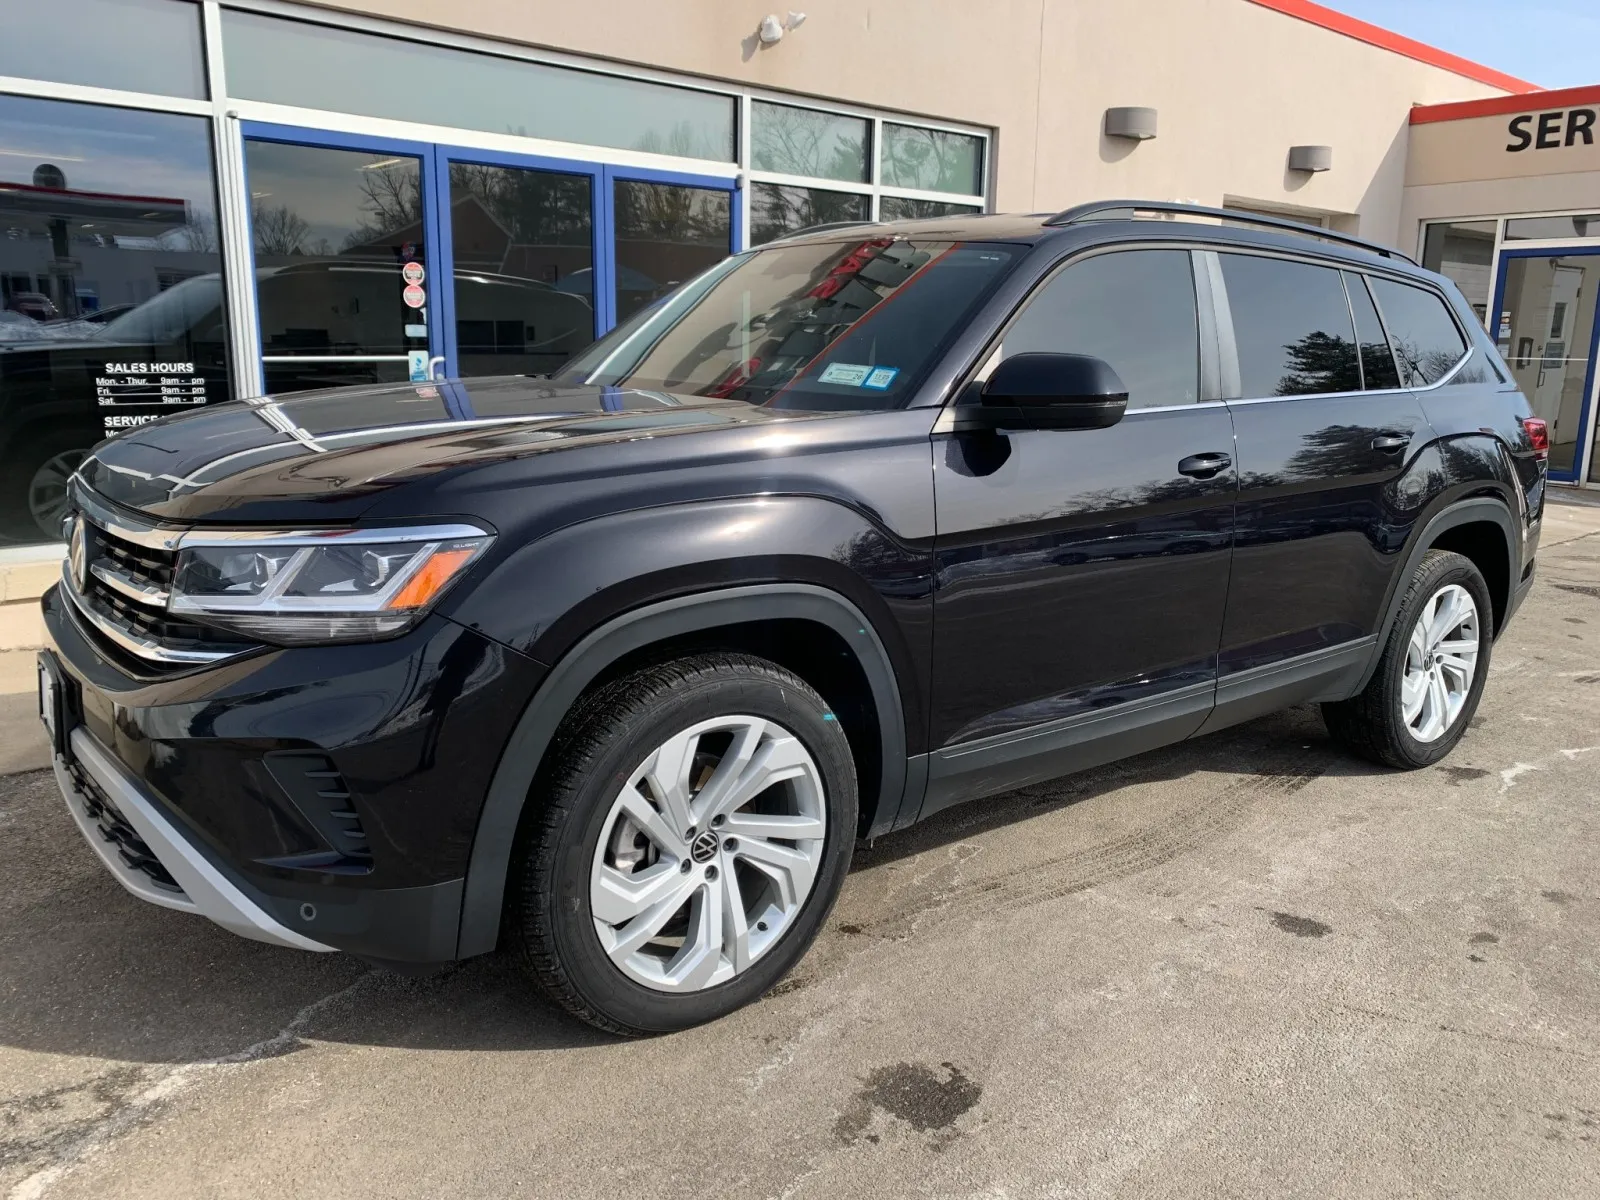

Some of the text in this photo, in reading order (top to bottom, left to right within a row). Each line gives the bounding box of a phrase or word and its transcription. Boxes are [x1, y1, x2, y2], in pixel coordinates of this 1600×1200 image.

[1506, 109, 1600, 153] SER
[105, 363, 194, 373] SALES HOURS
[95, 377, 119, 386] Mon.
[126, 377, 149, 385] Thur.
[160, 377, 180, 385] 9am
[191, 377, 204, 385] pm
[97, 387, 112, 396] Fri.
[160, 387, 180, 395] 9am
[191, 386, 205, 395] pm
[98, 397, 116, 406] Sat.
[162, 396, 181, 404] 9am
[193, 396, 206, 404] pm
